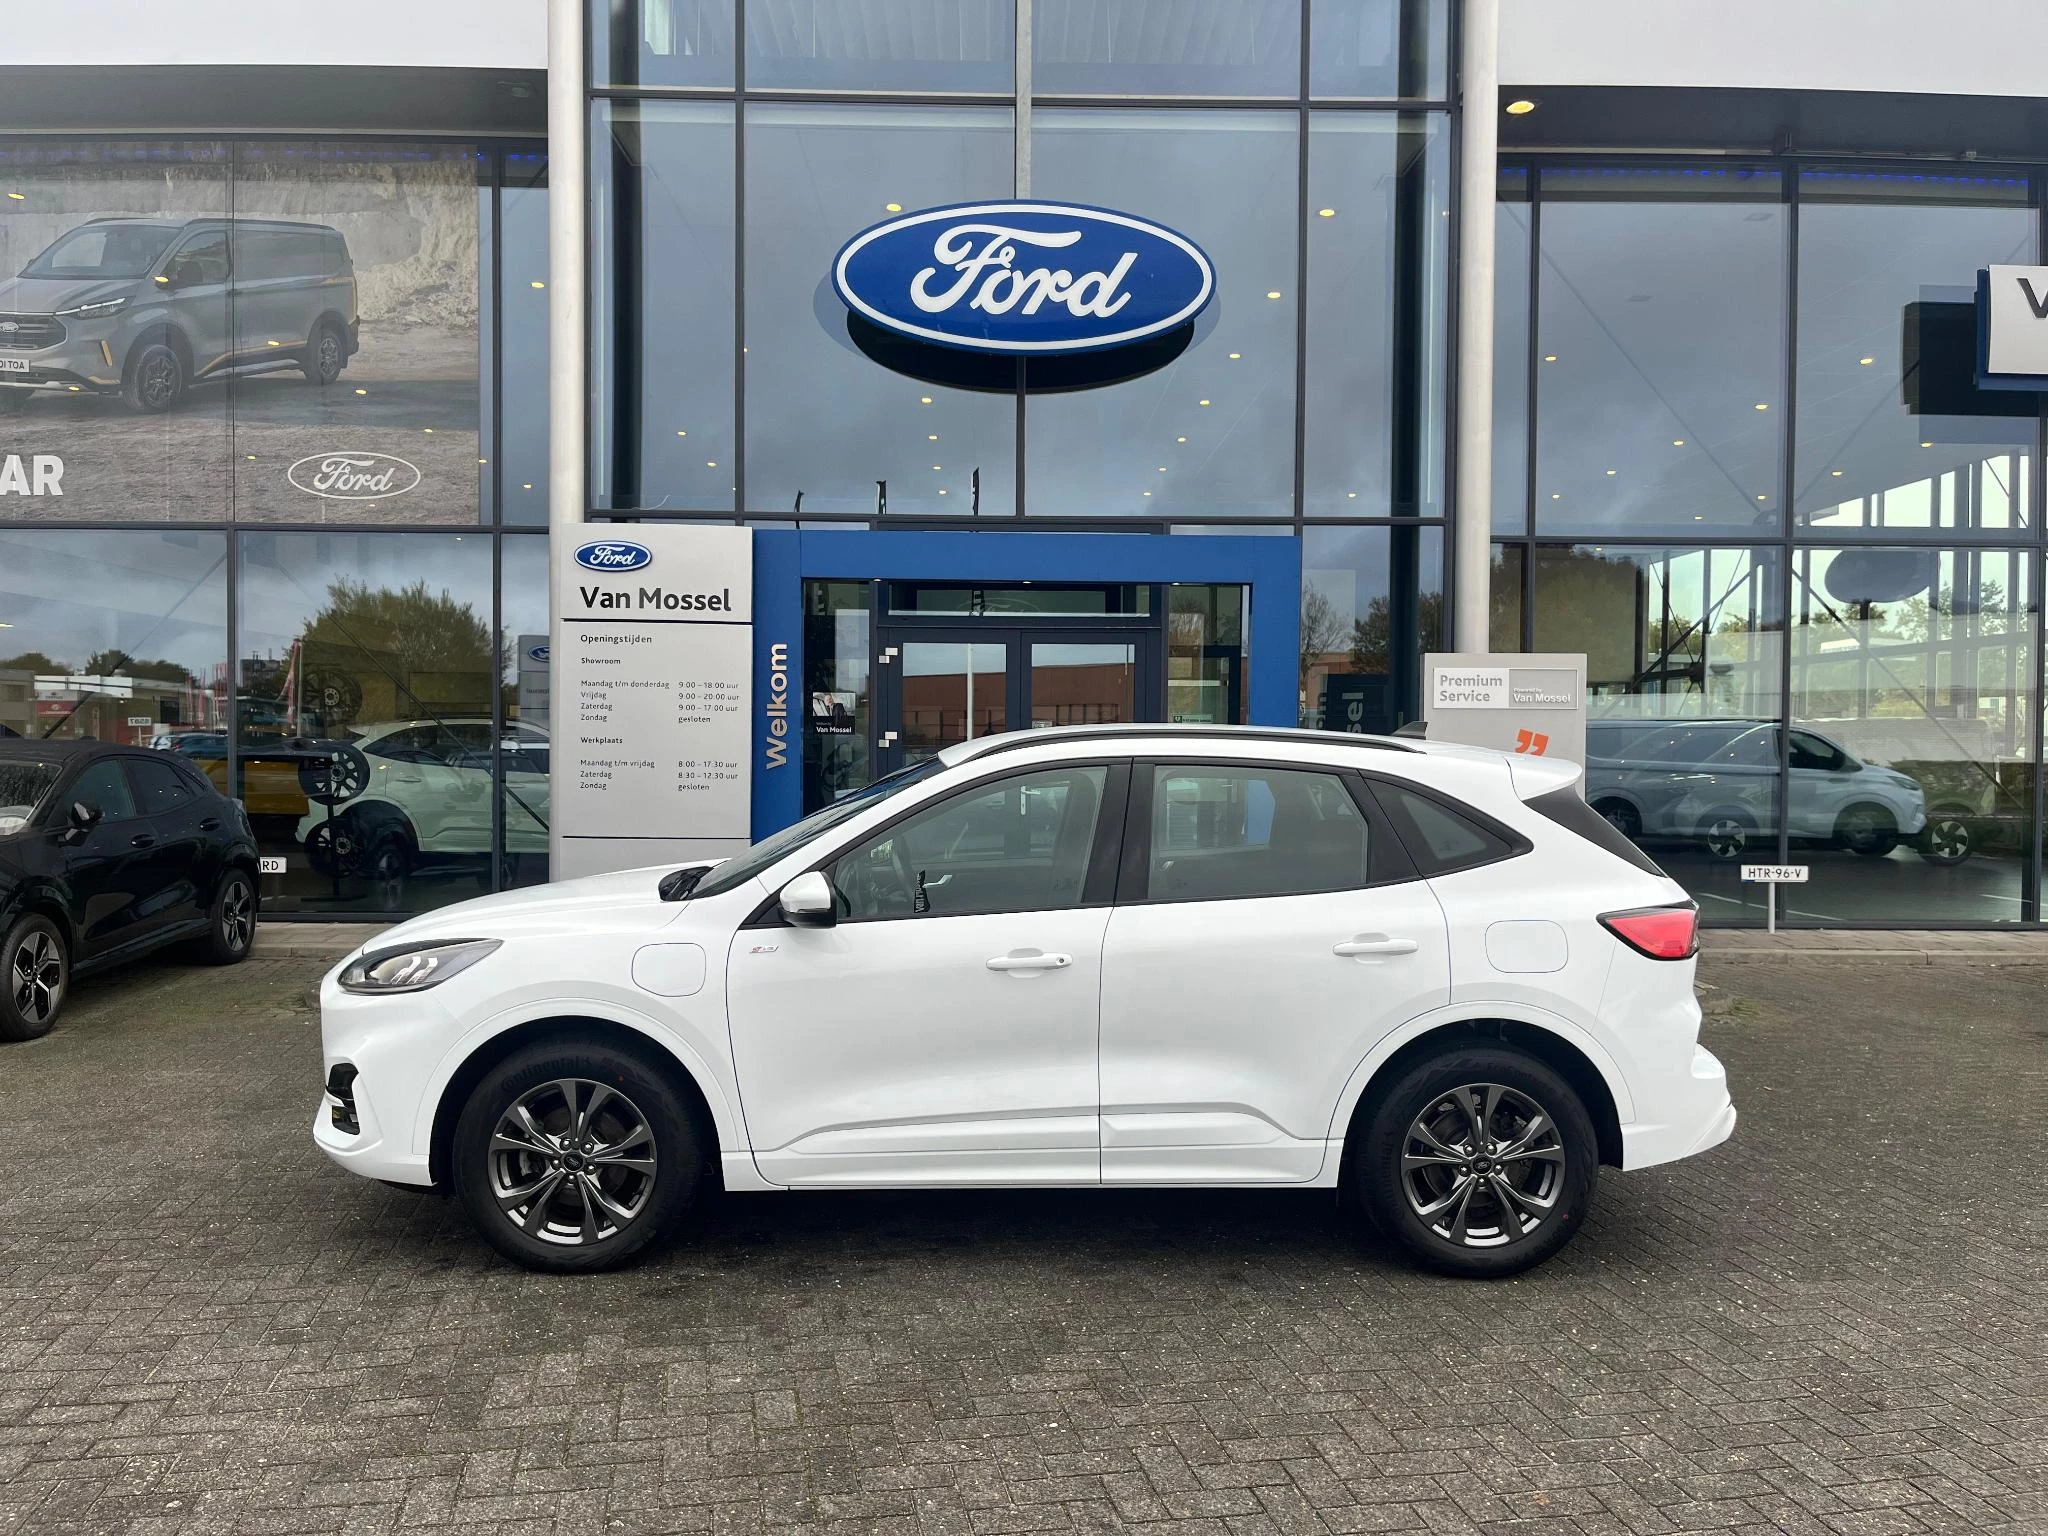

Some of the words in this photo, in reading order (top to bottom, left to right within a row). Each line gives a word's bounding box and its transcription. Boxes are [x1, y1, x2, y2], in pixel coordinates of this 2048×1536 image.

[910, 224, 1138, 317] Ford
[0, 455, 65, 496] AR
[313, 457, 395, 492] Ford
[589, 545, 637, 565] Ford
[580, 587, 631, 609] Van
[639, 588, 732, 612] Mossel
[580, 634, 652, 645] Openingstijden
[581, 657, 621, 665] Showroom
[581, 680, 613, 689] Maandag
[615, 680, 629, 688] t/m
[631, 680, 670, 690] donderdag
[1439, 675, 1503, 687] Premium
[581, 692, 607, 700] Vrijdag
[1439, 690, 1490, 702] Service
[1513, 693, 1532, 702] Van
[1535, 693, 1571, 703] Mossel
[580, 703, 613, 711] Zaterdag
[766, 643, 788, 770] Welkom
[580, 714, 607, 722] Zondag
[678, 715, 711, 724] gesloten
[580, 737, 623, 745] Werkplaats
[580, 760, 613, 768] Maandag
[630, 760, 655, 769] vrijdag
[580, 771, 612, 779] Zaterdag
[580, 782, 607, 790] Zondag
[678, 783, 710, 791] gesloten
[262, 860, 279, 870] RD
[1748, 867, 1802, 879] HTR-96-V
